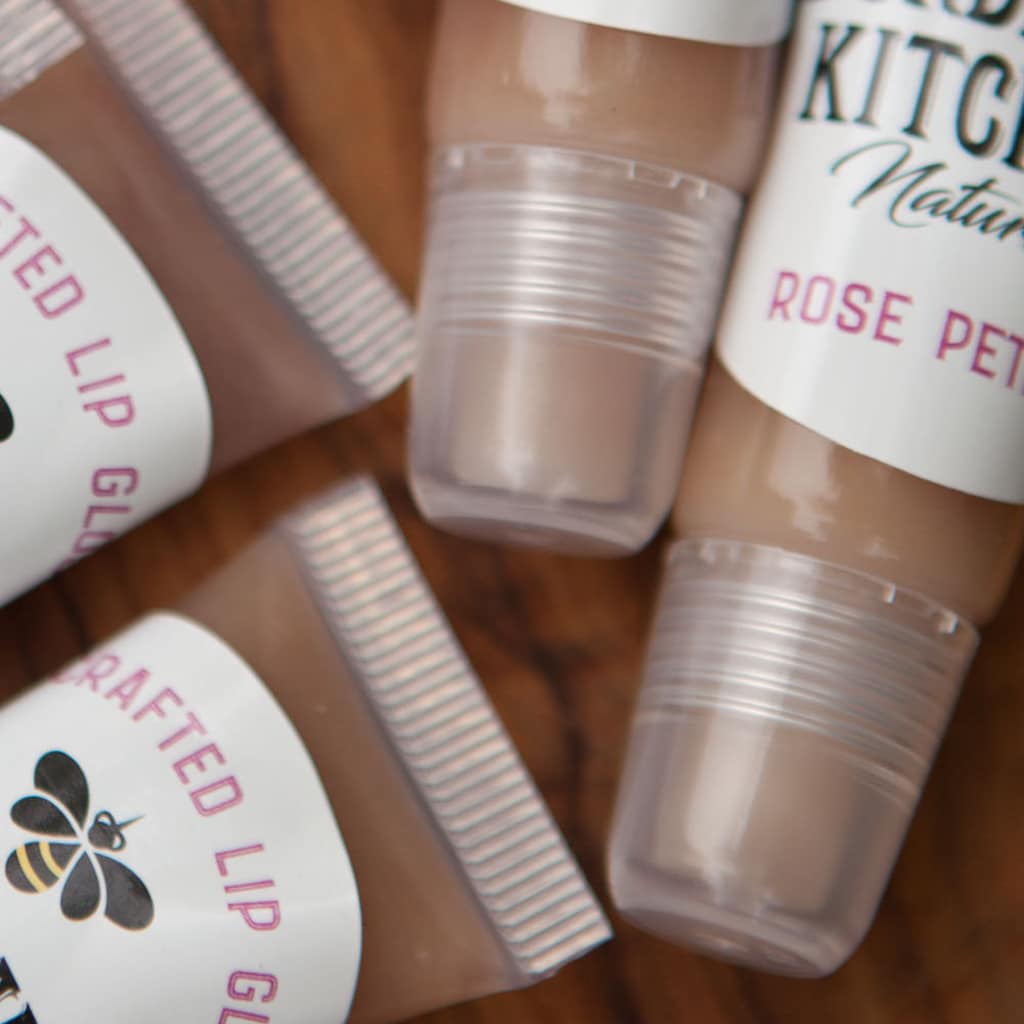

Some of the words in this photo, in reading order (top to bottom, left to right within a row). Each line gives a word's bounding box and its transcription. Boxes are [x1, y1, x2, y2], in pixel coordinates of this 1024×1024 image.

[798, 22, 1024, 172] KITC
[768, 271, 914, 347] ROSE
[64, 337, 135, 428] LIP
[51, 650, 244, 818] RAFTED
[214, 842, 281, 931] LIP
